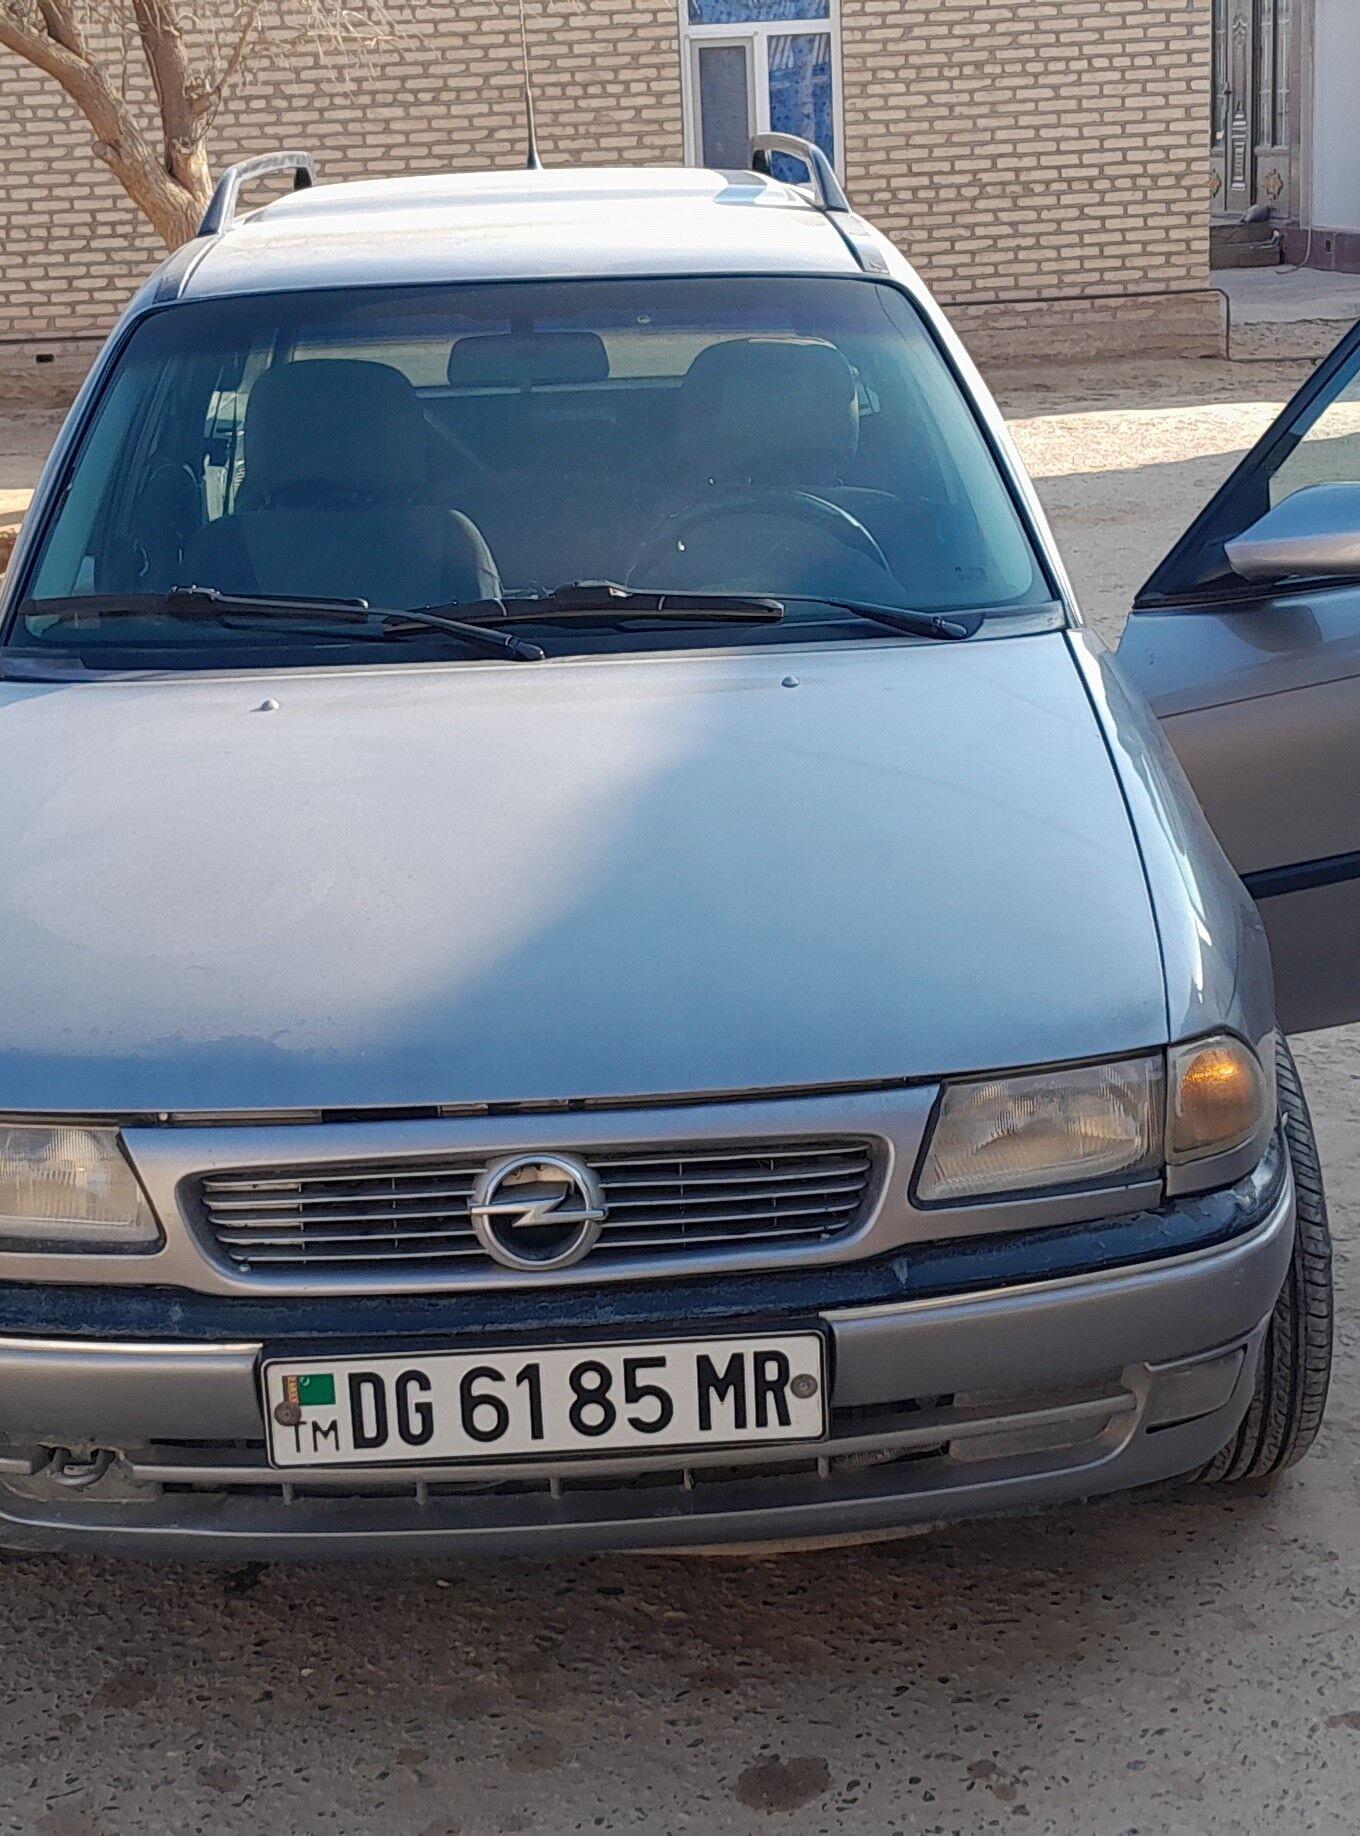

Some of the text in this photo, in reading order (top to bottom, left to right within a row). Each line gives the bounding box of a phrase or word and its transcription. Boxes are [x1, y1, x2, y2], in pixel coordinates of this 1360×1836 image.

[347, 1369, 434, 1449] DG
[696, 1350, 792, 1431] MR
[290, 1419, 340, 1453] TM
